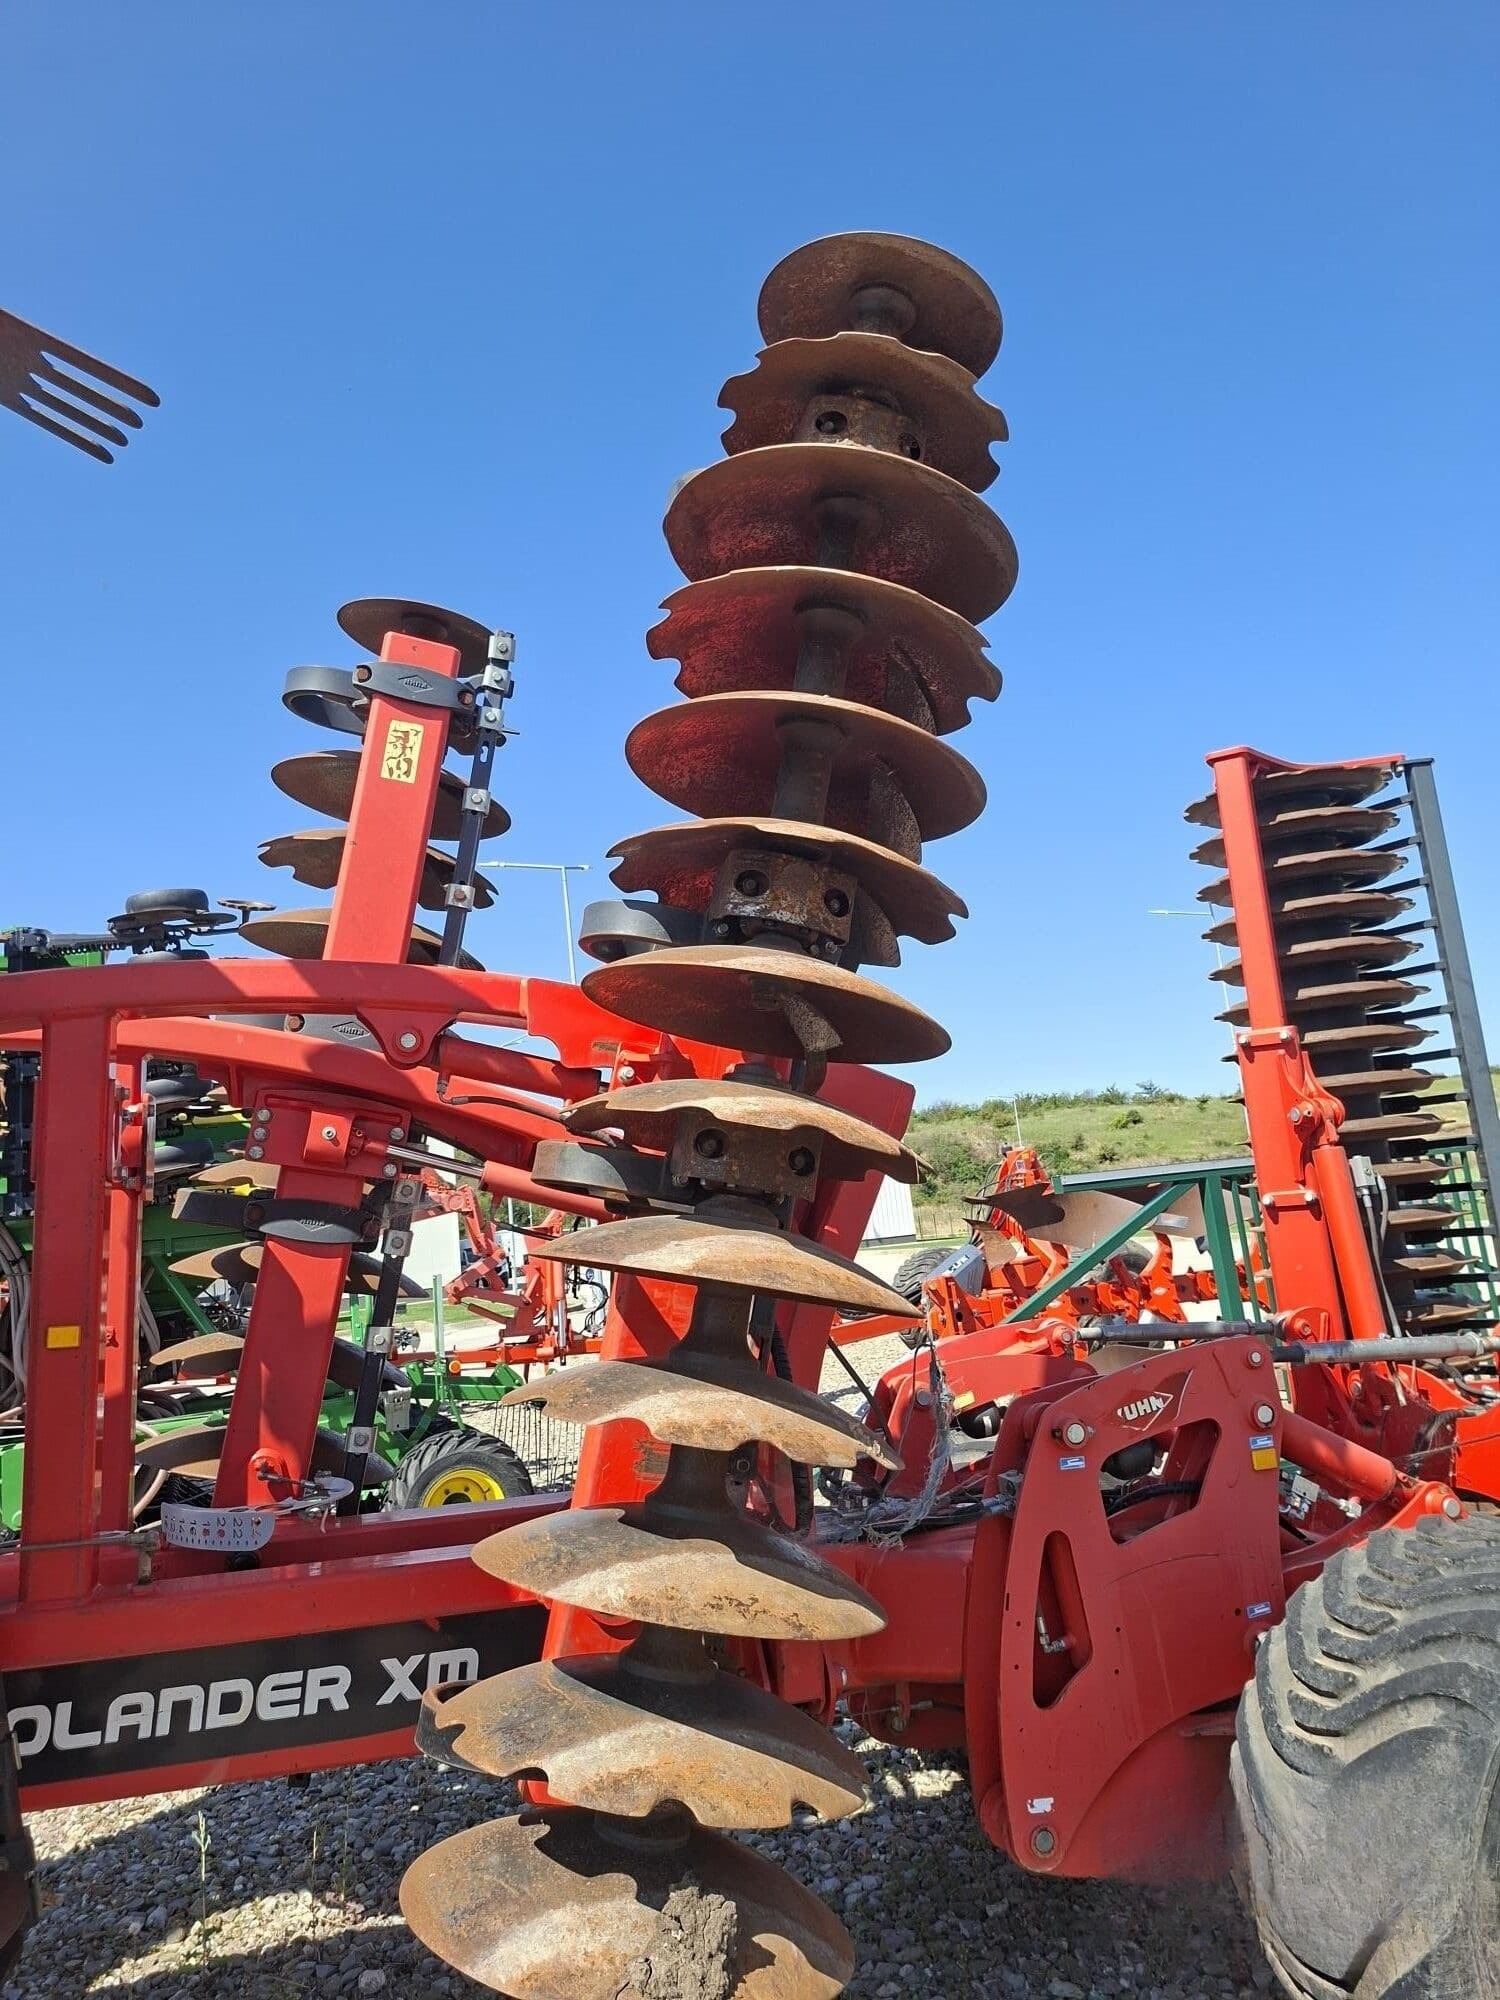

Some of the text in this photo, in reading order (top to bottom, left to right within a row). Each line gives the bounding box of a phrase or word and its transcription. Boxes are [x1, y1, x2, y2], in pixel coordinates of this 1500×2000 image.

[1117, 1396, 1164, 1420] UHN
[189, 1519, 197, 1536] 16
[233, 1518, 243, 1539] 22
